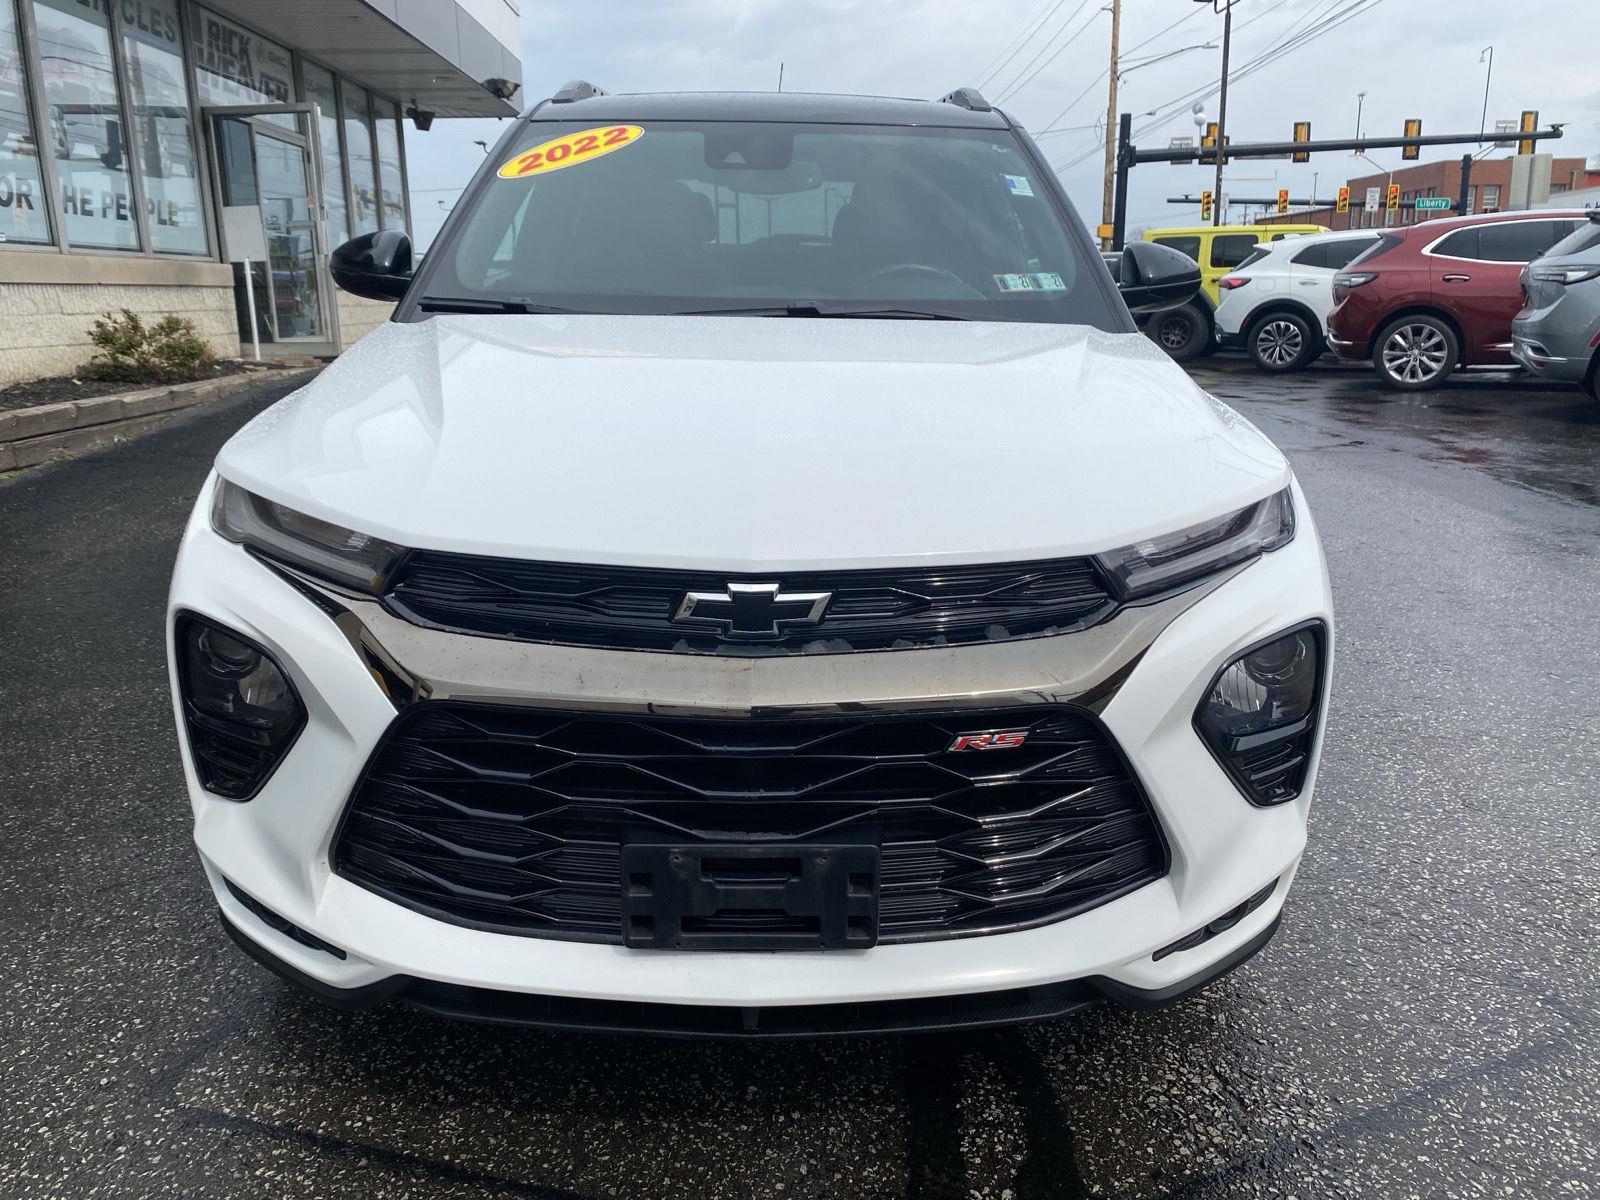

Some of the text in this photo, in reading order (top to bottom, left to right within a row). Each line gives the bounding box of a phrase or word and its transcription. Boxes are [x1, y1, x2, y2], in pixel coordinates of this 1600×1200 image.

[518, 127, 630, 175] 2022
[0, 176, 178, 227] OR HE PEPLE
[1419, 199, 1447, 208] Liberty
[948, 732, 1029, 751] RS
